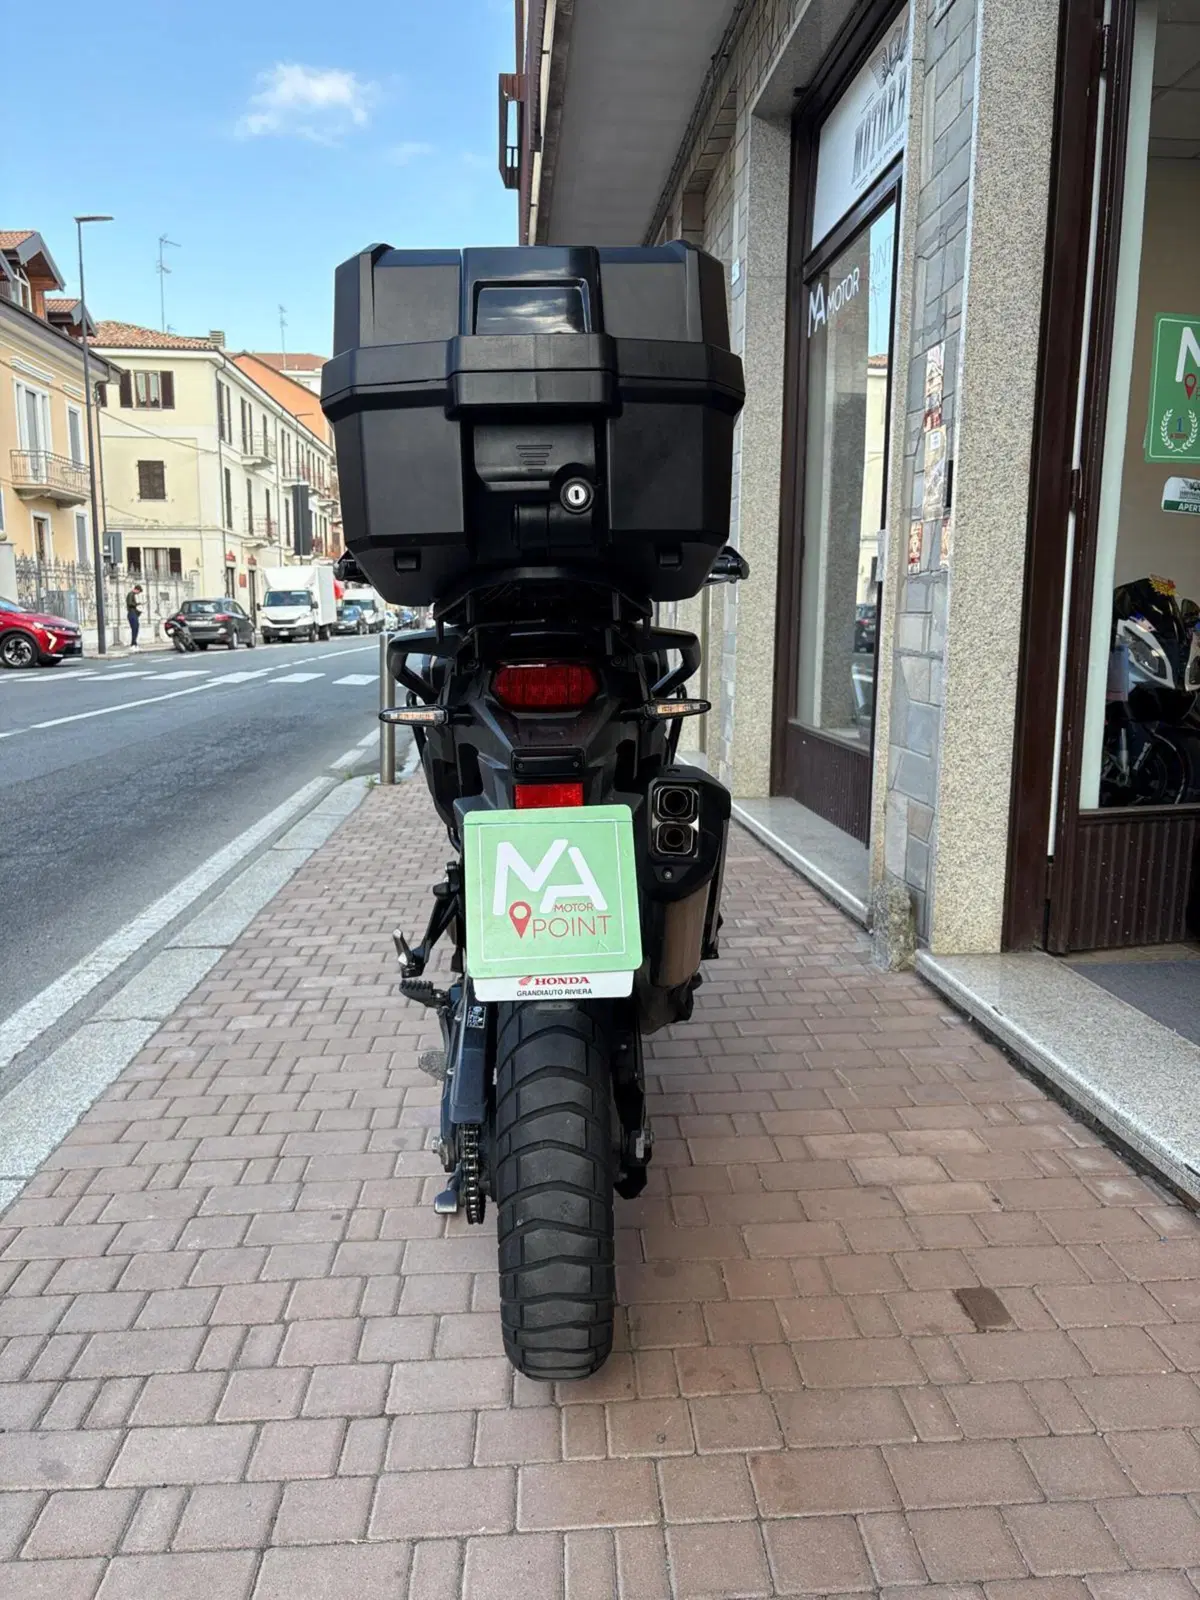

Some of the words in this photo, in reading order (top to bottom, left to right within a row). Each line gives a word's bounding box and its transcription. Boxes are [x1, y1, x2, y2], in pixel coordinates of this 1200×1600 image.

[827, 267, 860, 314] MOTOR
[493, 839, 608, 915] MA
[553, 902, 595, 913] MOTOR
[533, 915, 612, 938] POINT
[534, 976, 590, 986] HONDA
